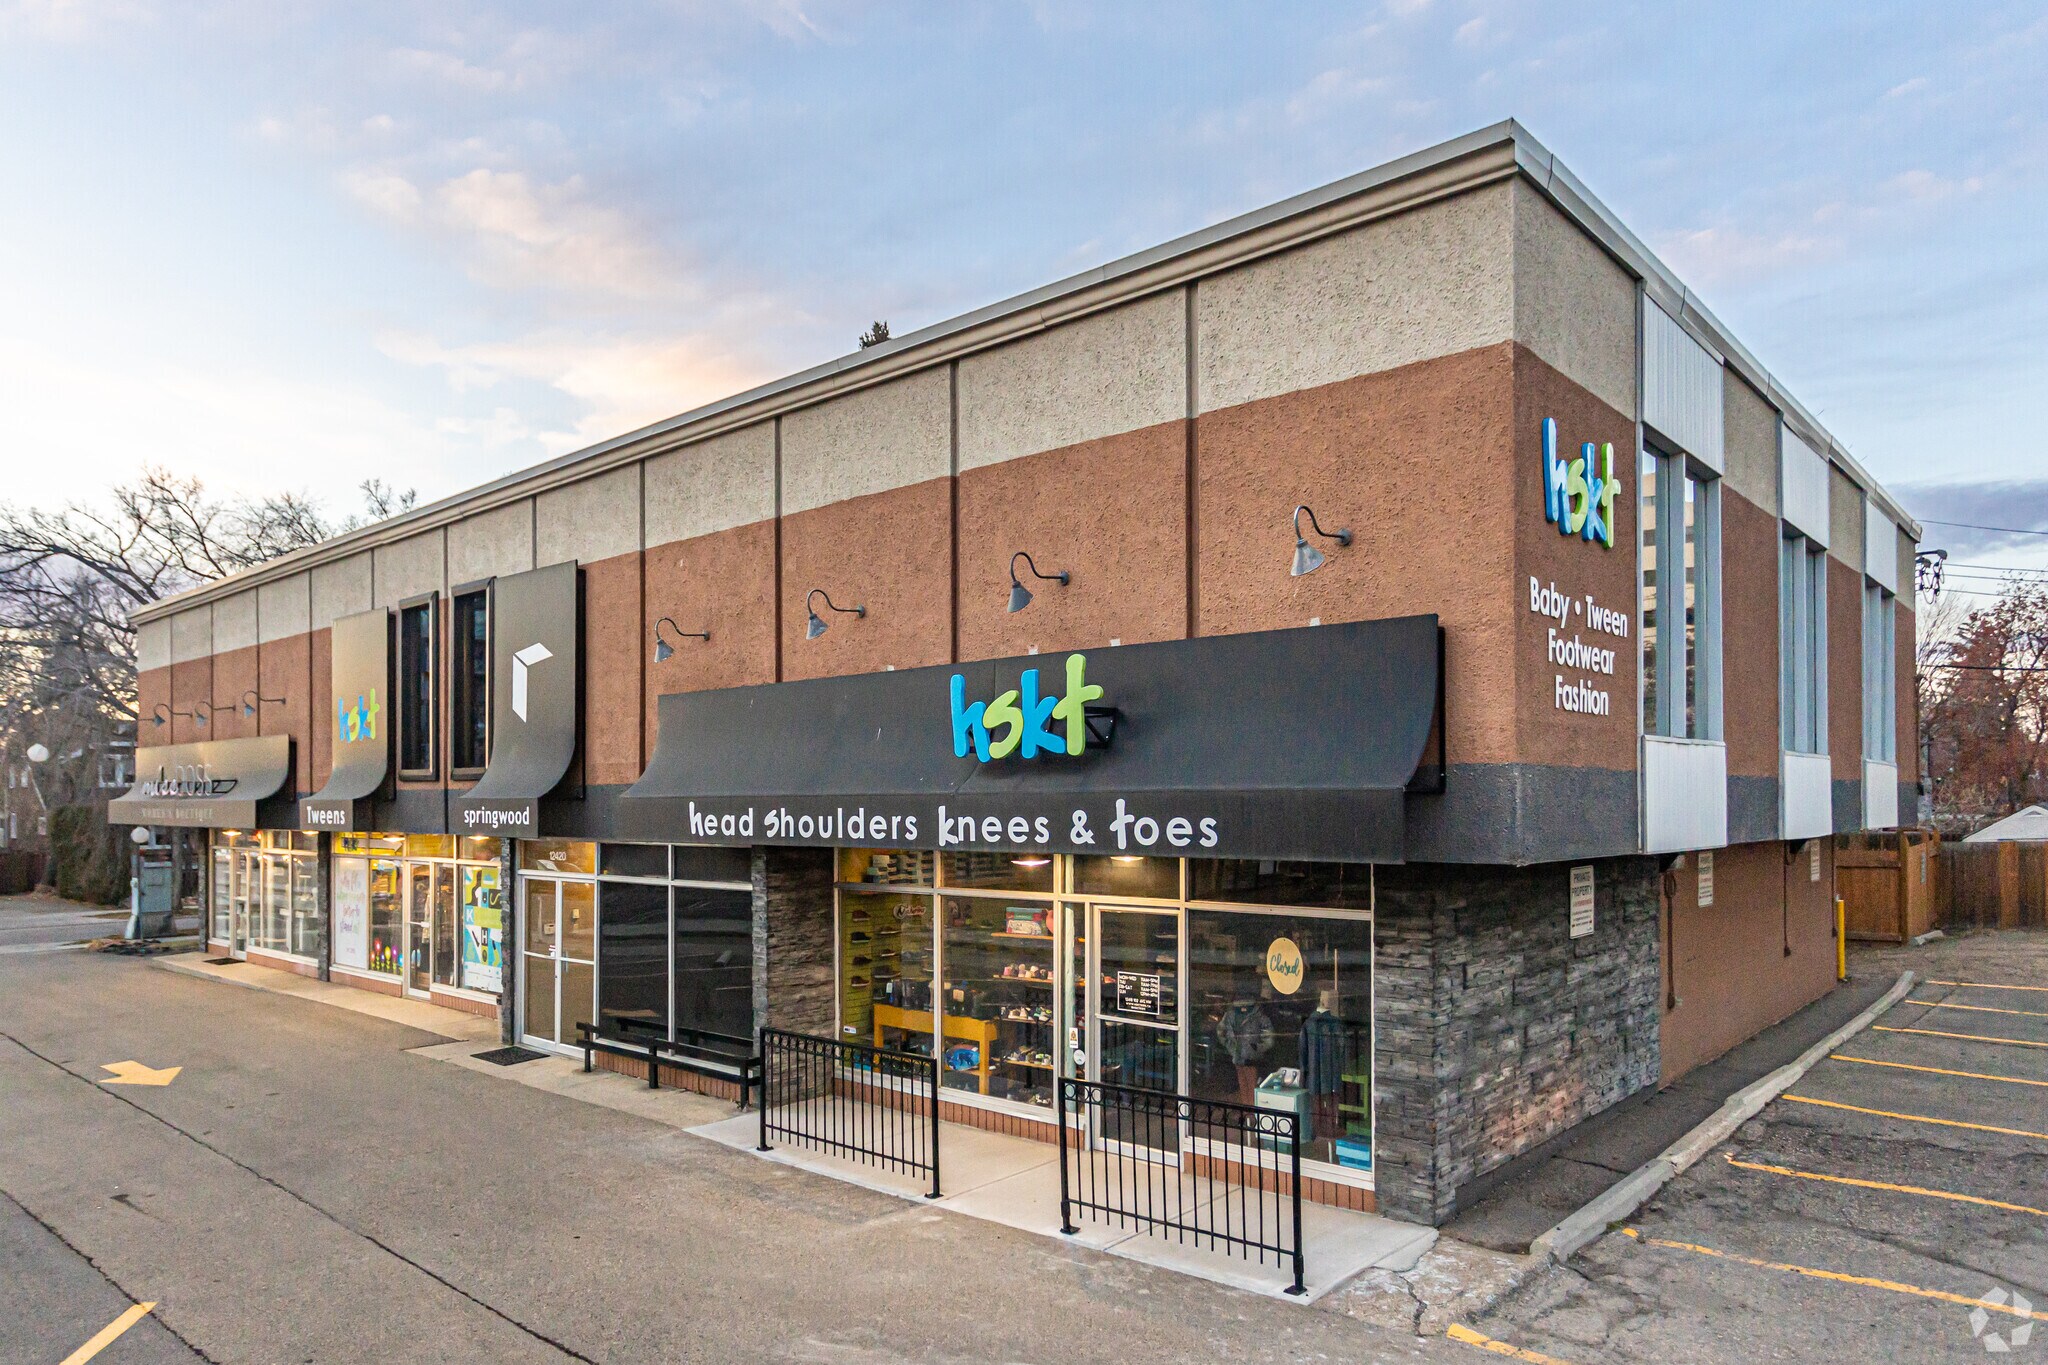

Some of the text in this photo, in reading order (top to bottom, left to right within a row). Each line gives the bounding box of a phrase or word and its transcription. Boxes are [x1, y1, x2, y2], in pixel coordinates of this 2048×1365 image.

[1541, 416, 1622, 549] hskt
[1529, 575, 1628, 638] Baby Tween
[1548, 627, 1615, 675] Footwear
[338, 687, 380, 743] hskt
[949, 653, 1104, 763] hskt
[1555, 675, 1609, 716] Fashion
[306, 805, 346, 825] Tweens
[463, 805, 530, 829] springwood
[688, 801, 755, 838] head
[938, 804, 1050, 846] knees
[1069, 810, 1096, 845] &
[1109, 797, 1218, 849] toes
[549, 850, 567, 861] 12420
